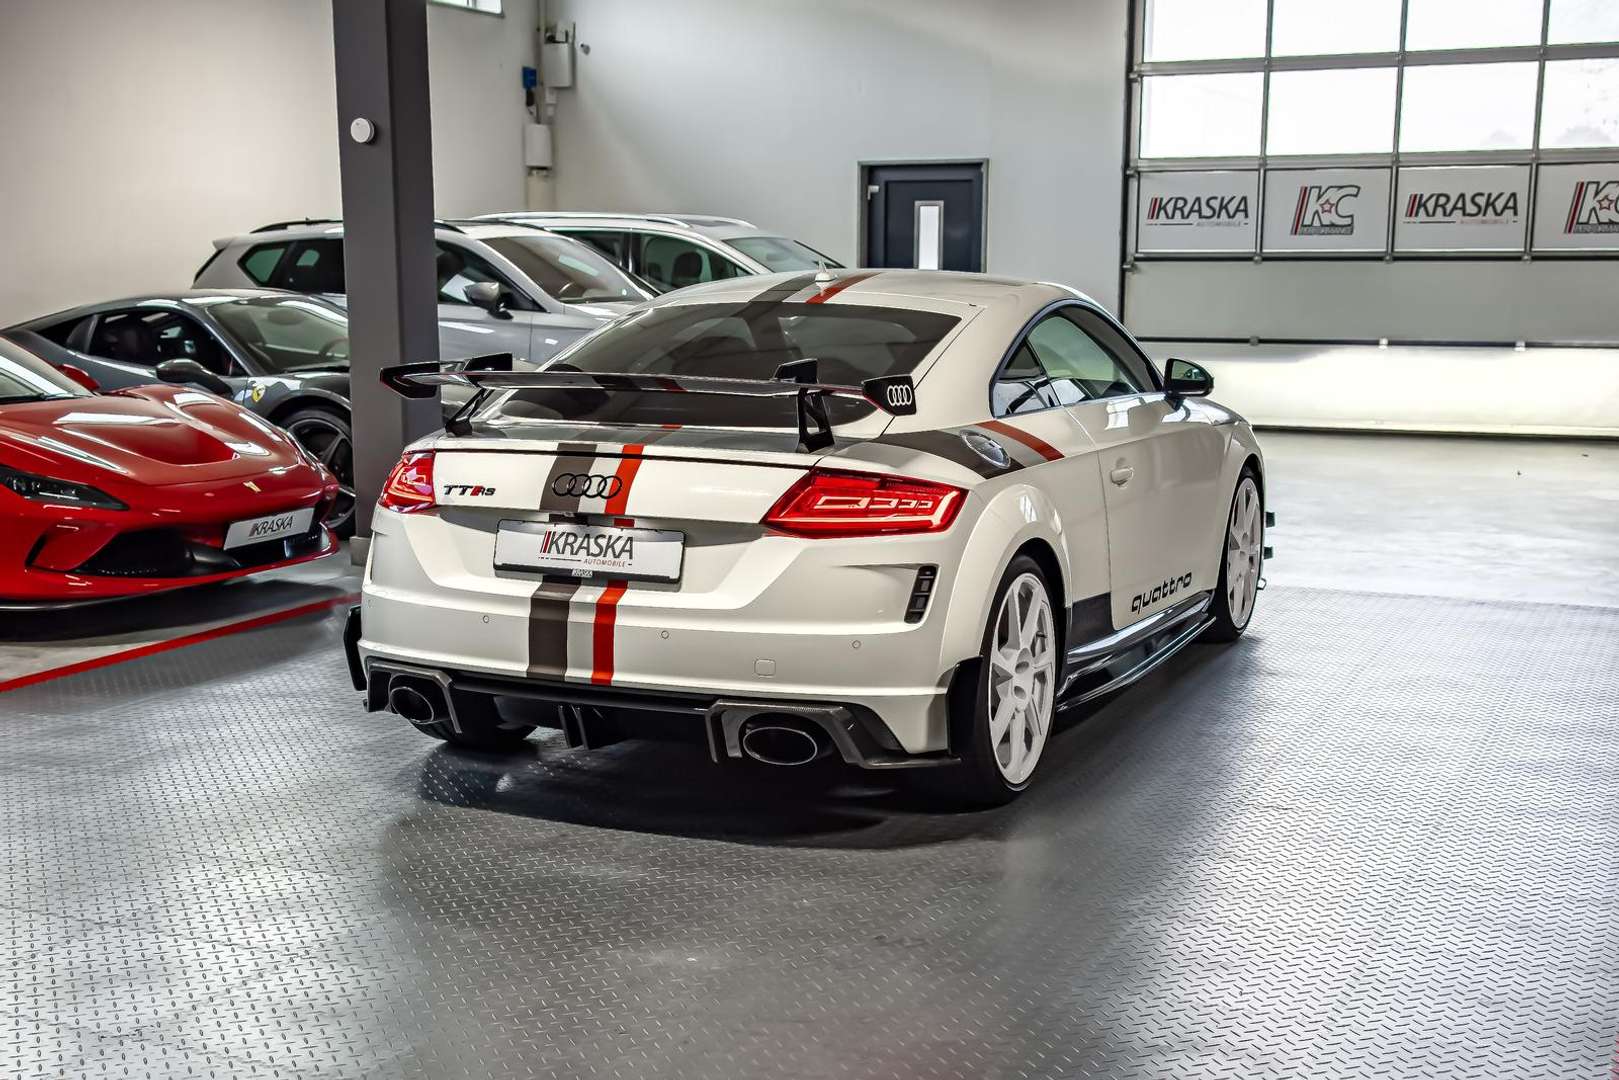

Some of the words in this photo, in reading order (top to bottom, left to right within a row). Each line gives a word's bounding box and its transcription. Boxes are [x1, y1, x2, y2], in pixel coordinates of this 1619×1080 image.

[1155, 195, 1249, 220] KRASKA
[1414, 192, 1518, 217] KRASKA
[1576, 181, 1619, 225] K
[255, 515, 293, 535] KRASKA
[547, 530, 634, 560] KRASKA
[583, 558, 626, 568] AUTOMOBILE
[1131, 572, 1192, 614] quattro
